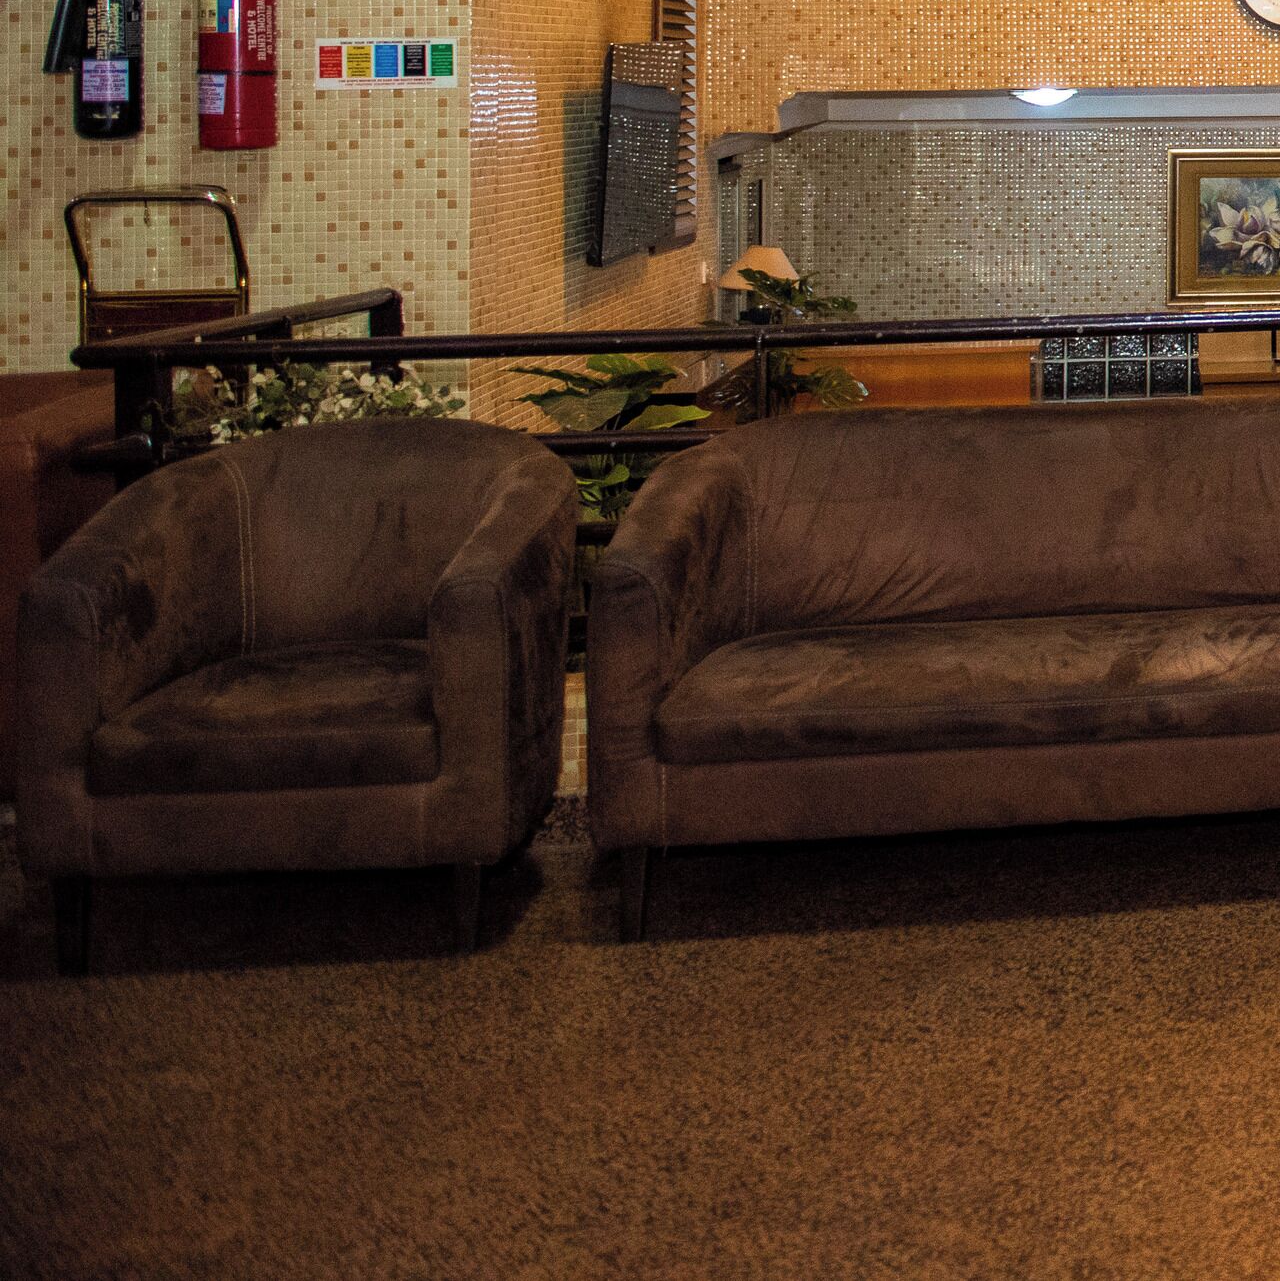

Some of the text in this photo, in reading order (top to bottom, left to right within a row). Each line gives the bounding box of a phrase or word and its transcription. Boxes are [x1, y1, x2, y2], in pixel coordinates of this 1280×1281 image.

[87, 18, 97, 49] HOTEL
[247, 20, 257, 50] HOTEL
[256, 0, 267, 60] WELCOME CENTRE
